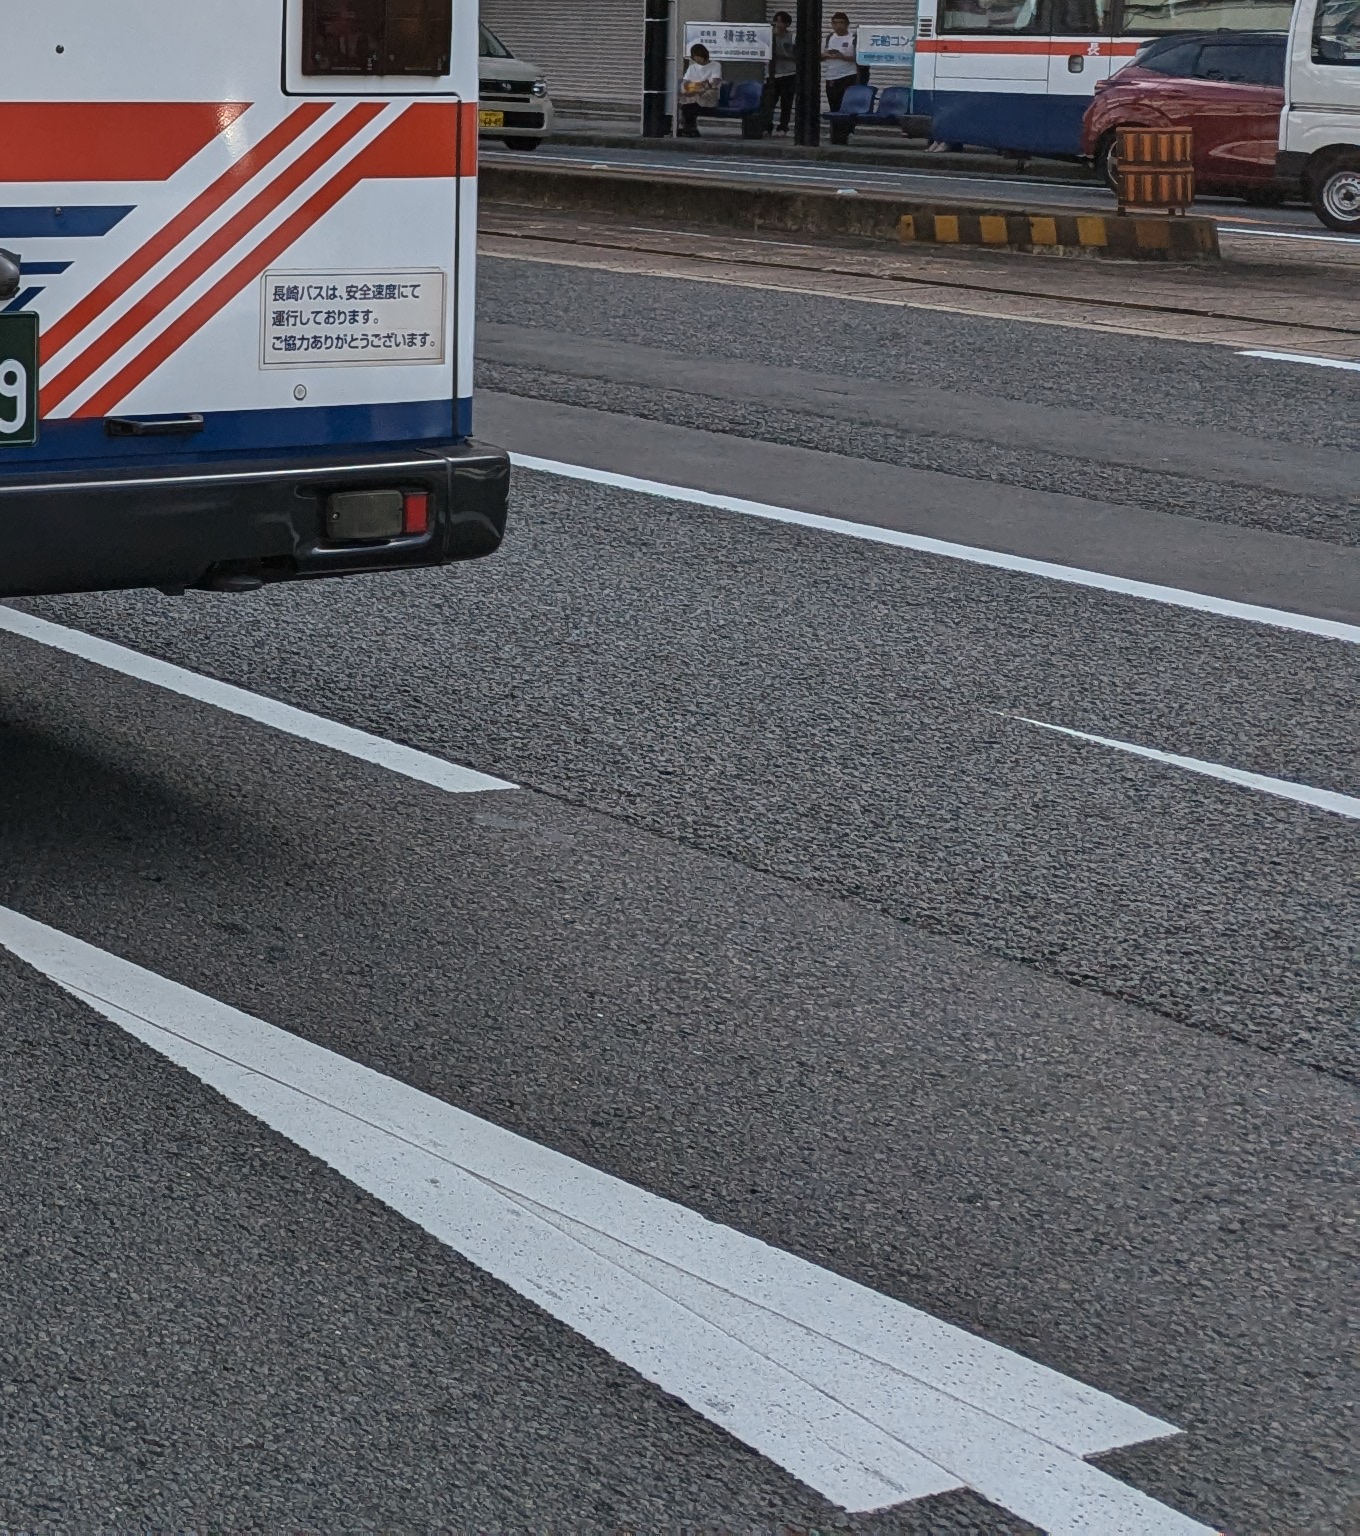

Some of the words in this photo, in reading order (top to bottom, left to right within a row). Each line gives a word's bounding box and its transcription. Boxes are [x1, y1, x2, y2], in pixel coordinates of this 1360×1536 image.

[272, 283, 422, 302] 長崎バスは、安全速度にて
[271, 309, 380, 327] 運行しております。
[271, 331, 436, 352] ご協力ありがとうございます。
